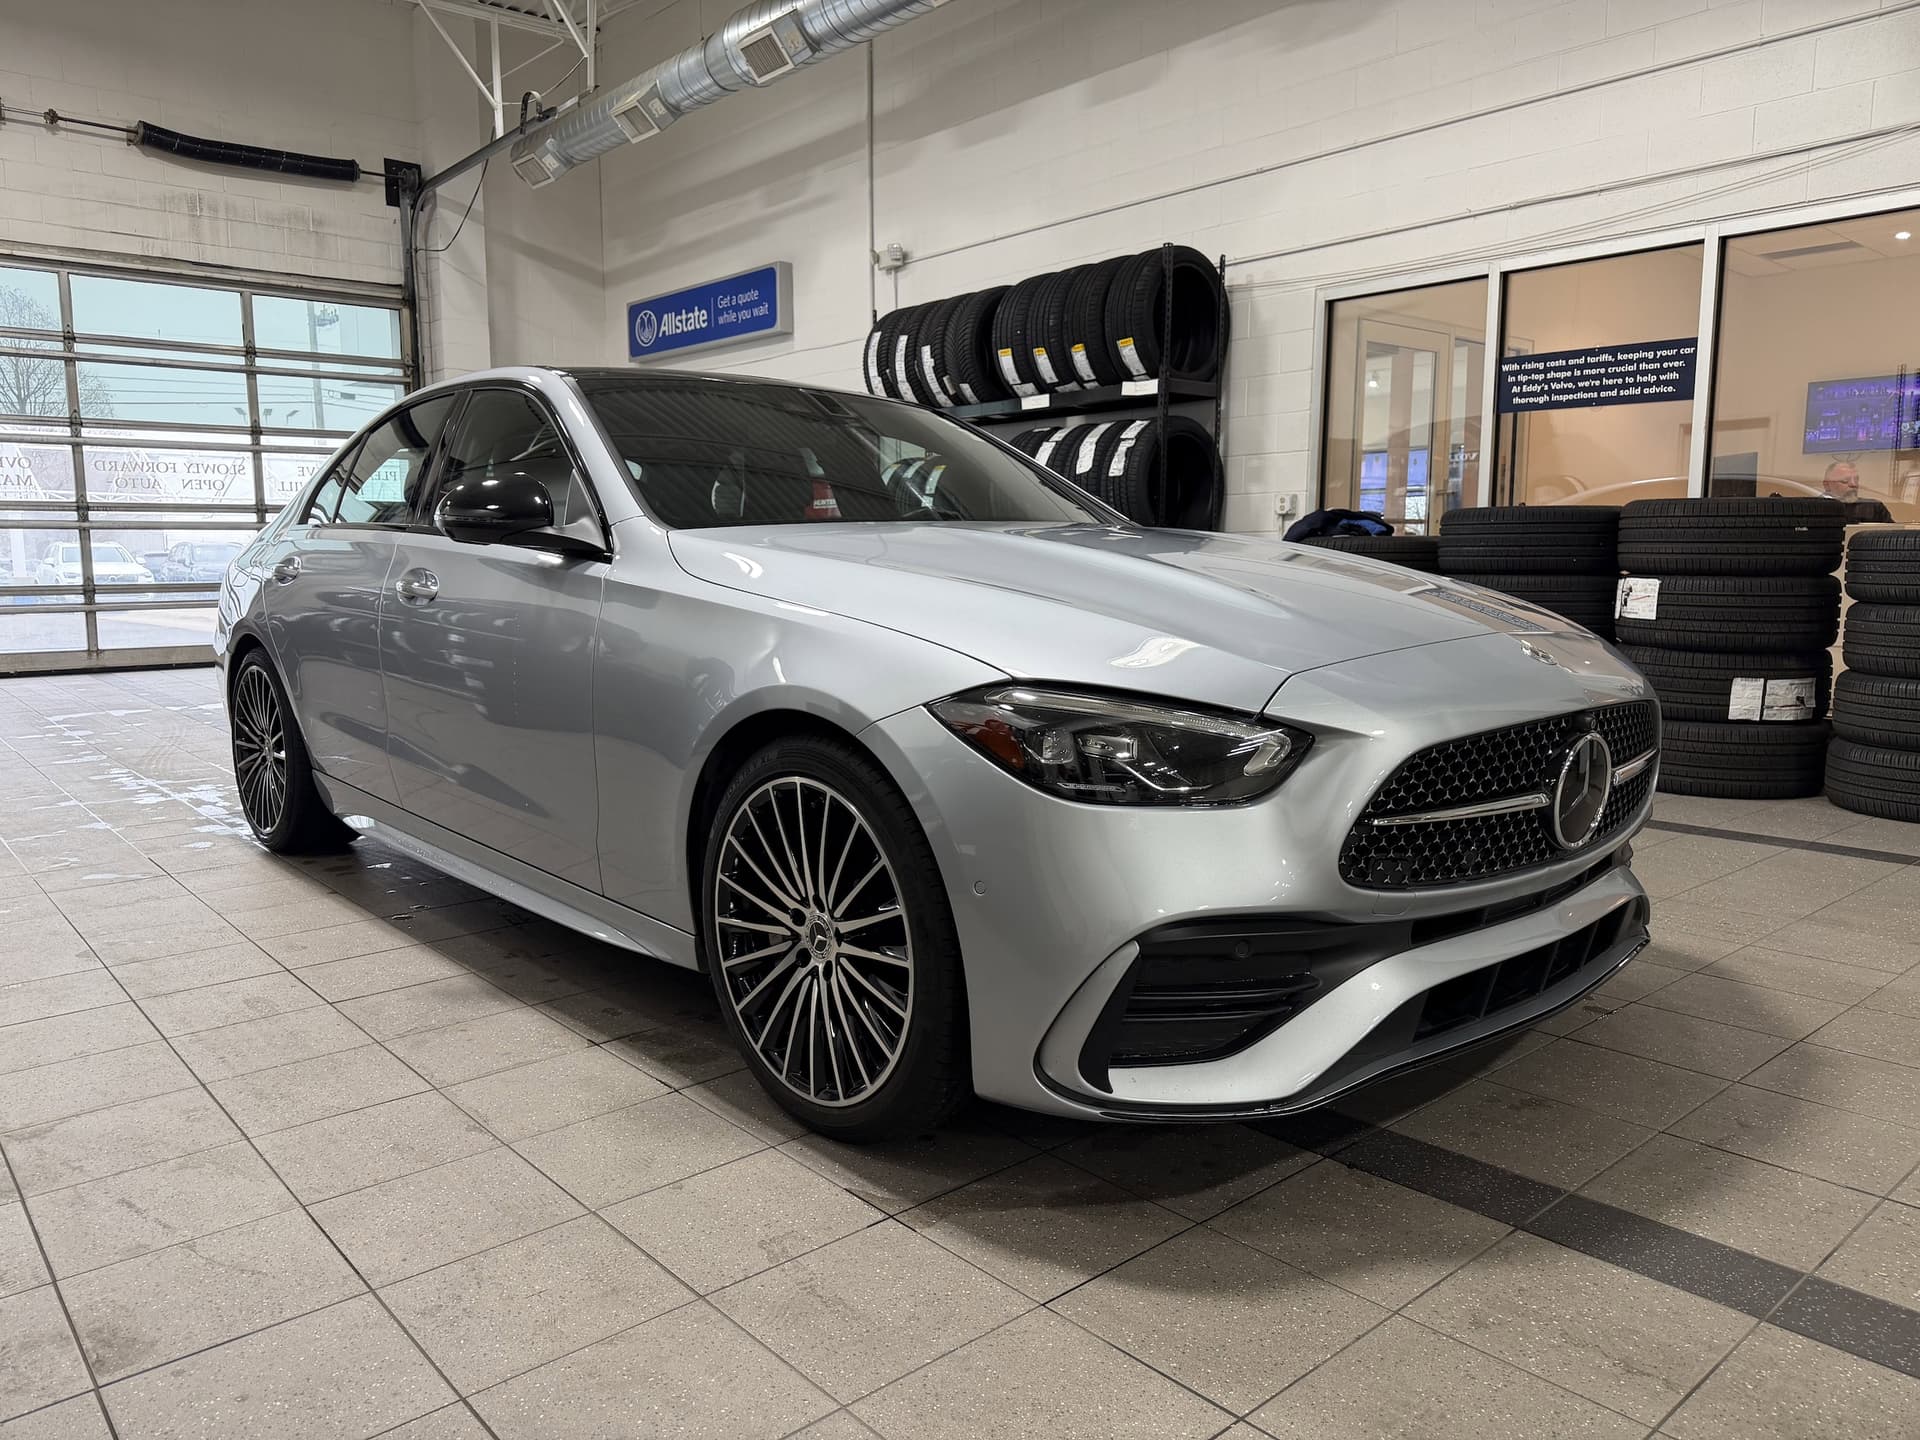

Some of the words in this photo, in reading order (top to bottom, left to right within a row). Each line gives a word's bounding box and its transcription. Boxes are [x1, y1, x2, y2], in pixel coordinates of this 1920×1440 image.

[717, 295, 730, 309] Get
[732, 296, 737, 304] a
[738, 288, 759, 306] quote
[659, 306, 708, 338] Allstate
[718, 310, 737, 325] while
[738, 309, 751, 324] you
[752, 302, 769, 317] wait
[1501, 362, 1520, 372] With
[1521, 361, 1545, 370] rising
[1546, 358, 1566, 368] costs
[1568, 356, 1585, 365] and
[1587, 353, 1615, 363] tariffs,
[1617, 350, 1655, 361] keeping
[1656, 347, 1678, 358] your
[1679, 346, 1696, 354] car
[1507, 374, 1516, 383] in
[1517, 372, 1545, 383] tip-top
[1546, 370, 1572, 380] shape
[1574, 368, 1581, 377] is
[1583, 367, 1606, 376] more
[1608, 363, 1637, 373] crucial
[1639, 361, 1660, 371] than
[1662, 360, 1686, 369] ever.
[1511, 385, 1521, 393] At
[1550, 381, 1576, 390] Volvo,
[1602, 377, 1623, 386] here
[1625, 376, 1635, 384] to
[1636, 373, 1657, 383] help
[1659, 371, 1679, 380] with
[1512, 394, 1550, 405] thorough
[1551, 391, 1598, 403] inspections
[1600, 388, 1618, 398] and
[1619, 385, 1641, 396] solid
[1643, 384, 1676, 394] advice.
